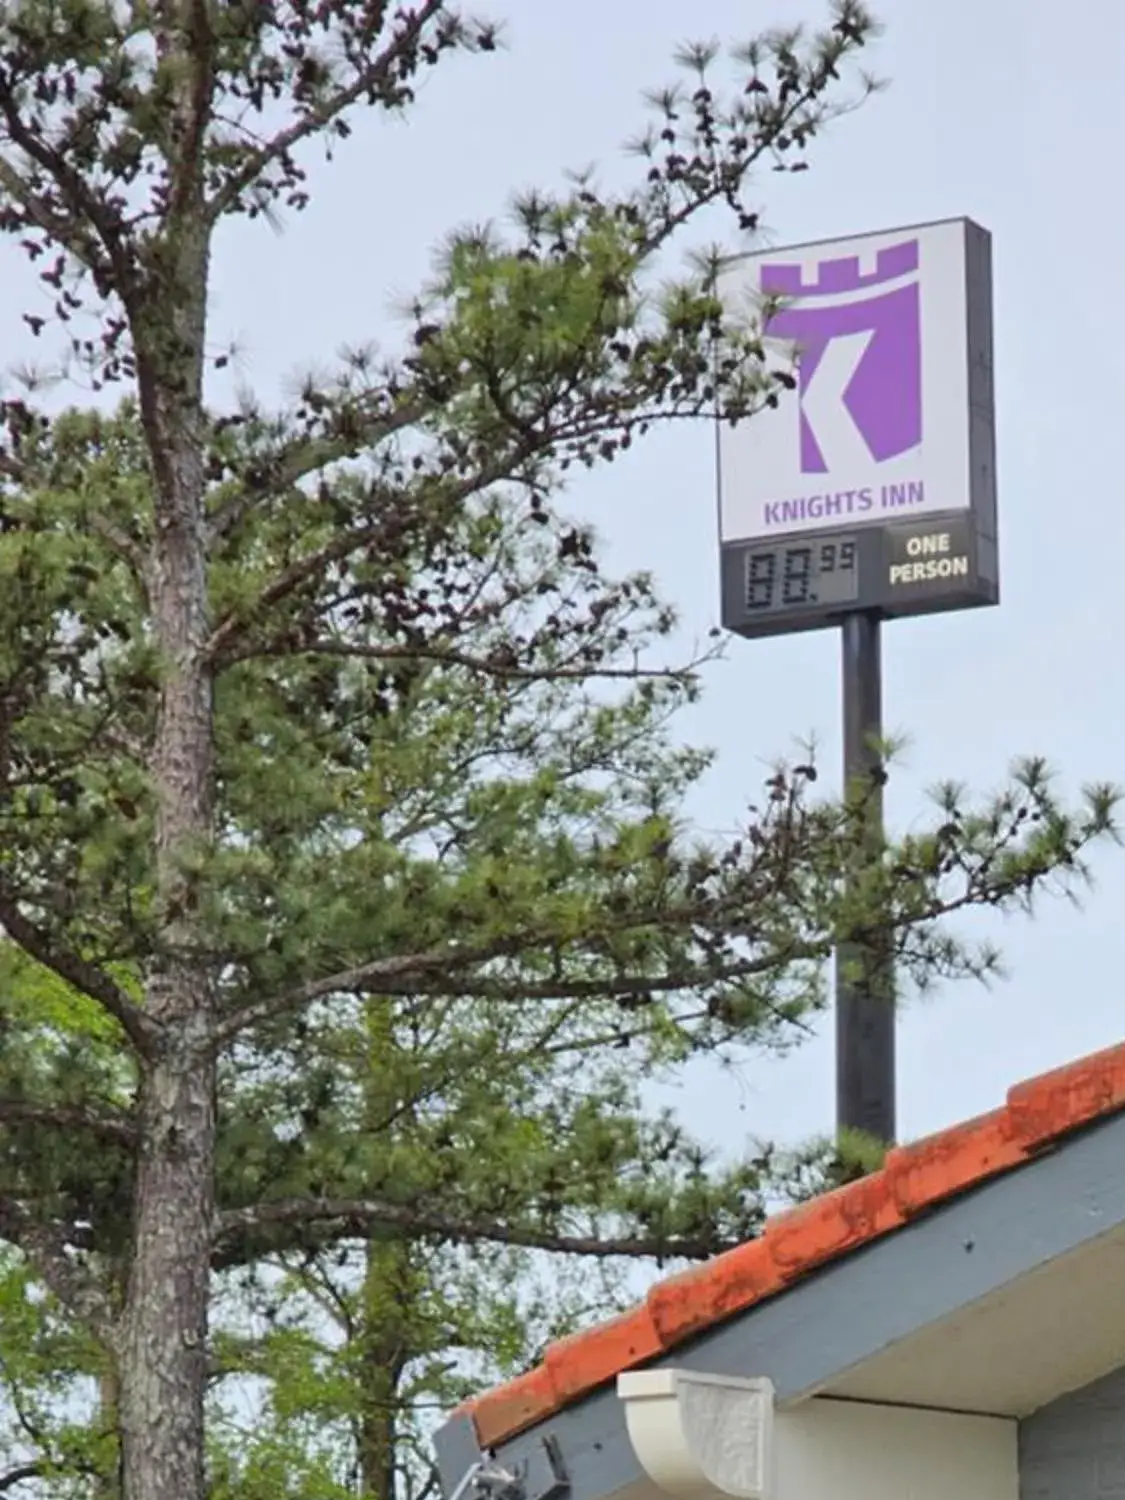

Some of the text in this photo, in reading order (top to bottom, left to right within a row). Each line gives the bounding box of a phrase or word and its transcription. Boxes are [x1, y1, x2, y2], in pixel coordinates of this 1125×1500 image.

[764, 480, 925, 525] KNIGHTS INN
[907, 533, 950, 556] ONE
[889, 556, 969, 585] PERSON
